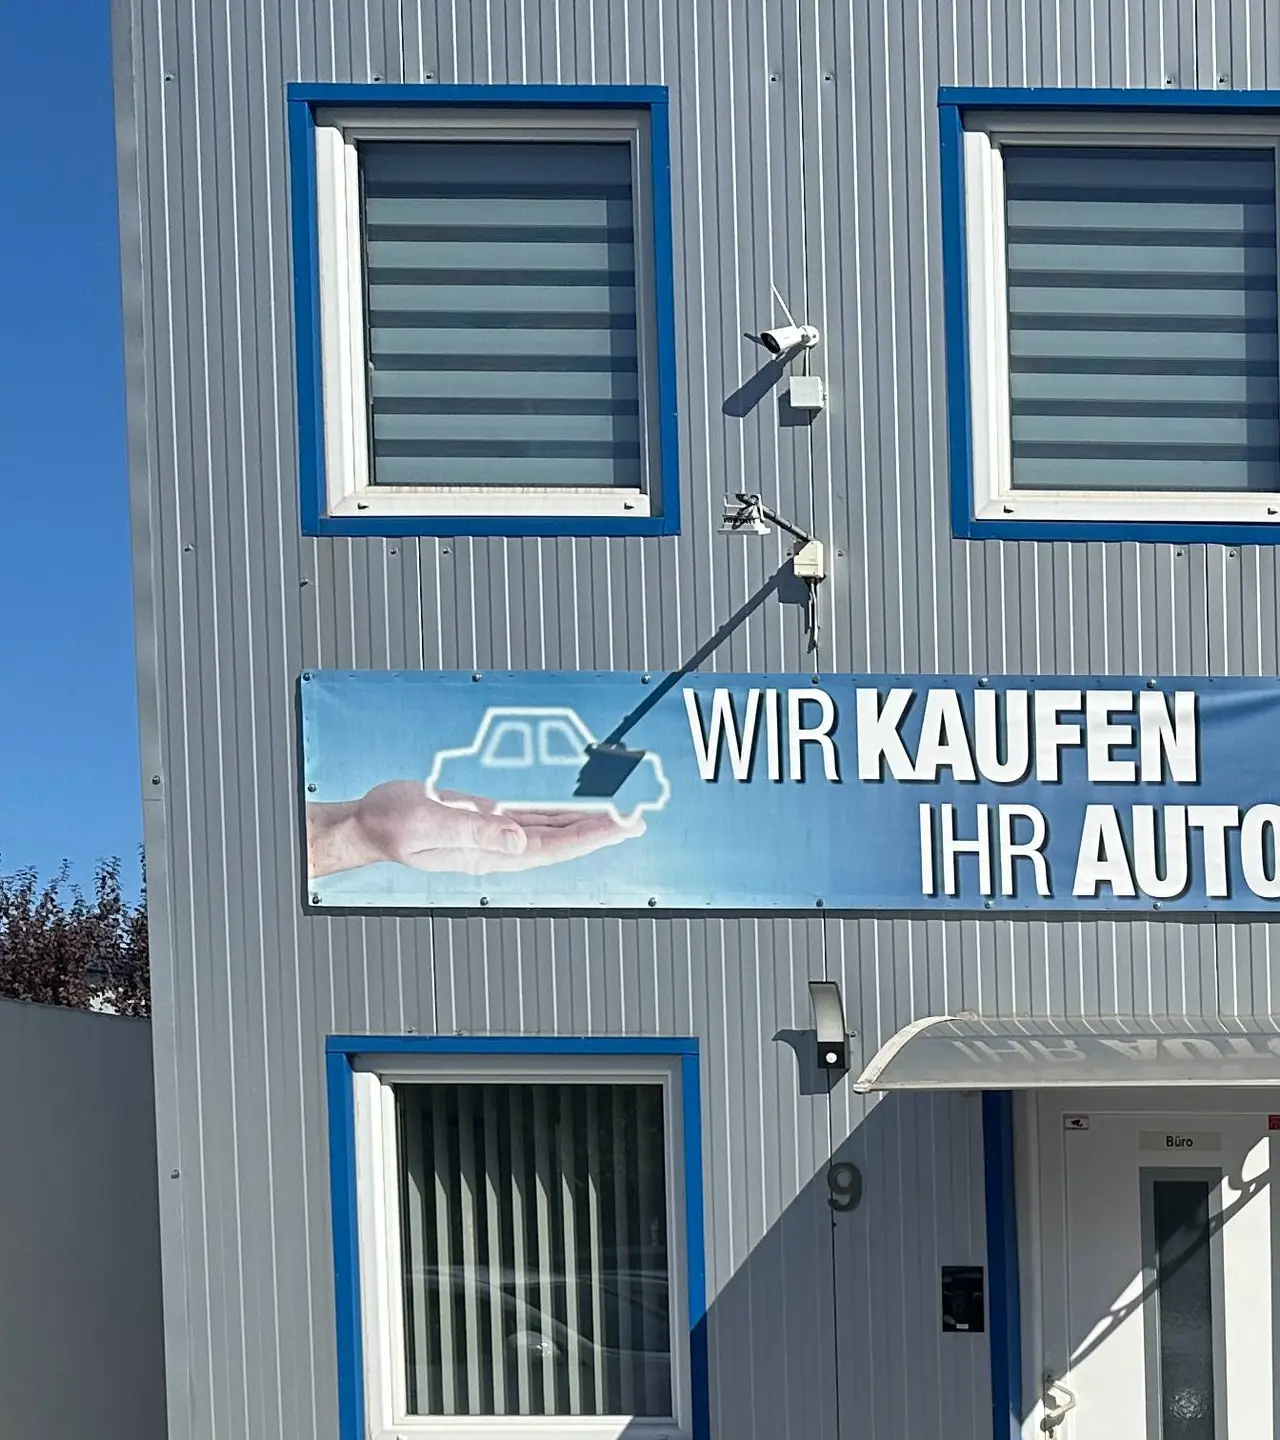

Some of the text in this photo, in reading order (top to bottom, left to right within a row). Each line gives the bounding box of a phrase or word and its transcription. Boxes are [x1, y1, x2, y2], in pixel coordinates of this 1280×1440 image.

[682, 687, 1197, 783] WIR KAUFEN
[920, 803, 1051, 897] IHR
[1165, 1135, 1194, 1148] Büro
[826, 1161, 863, 1212] 9
